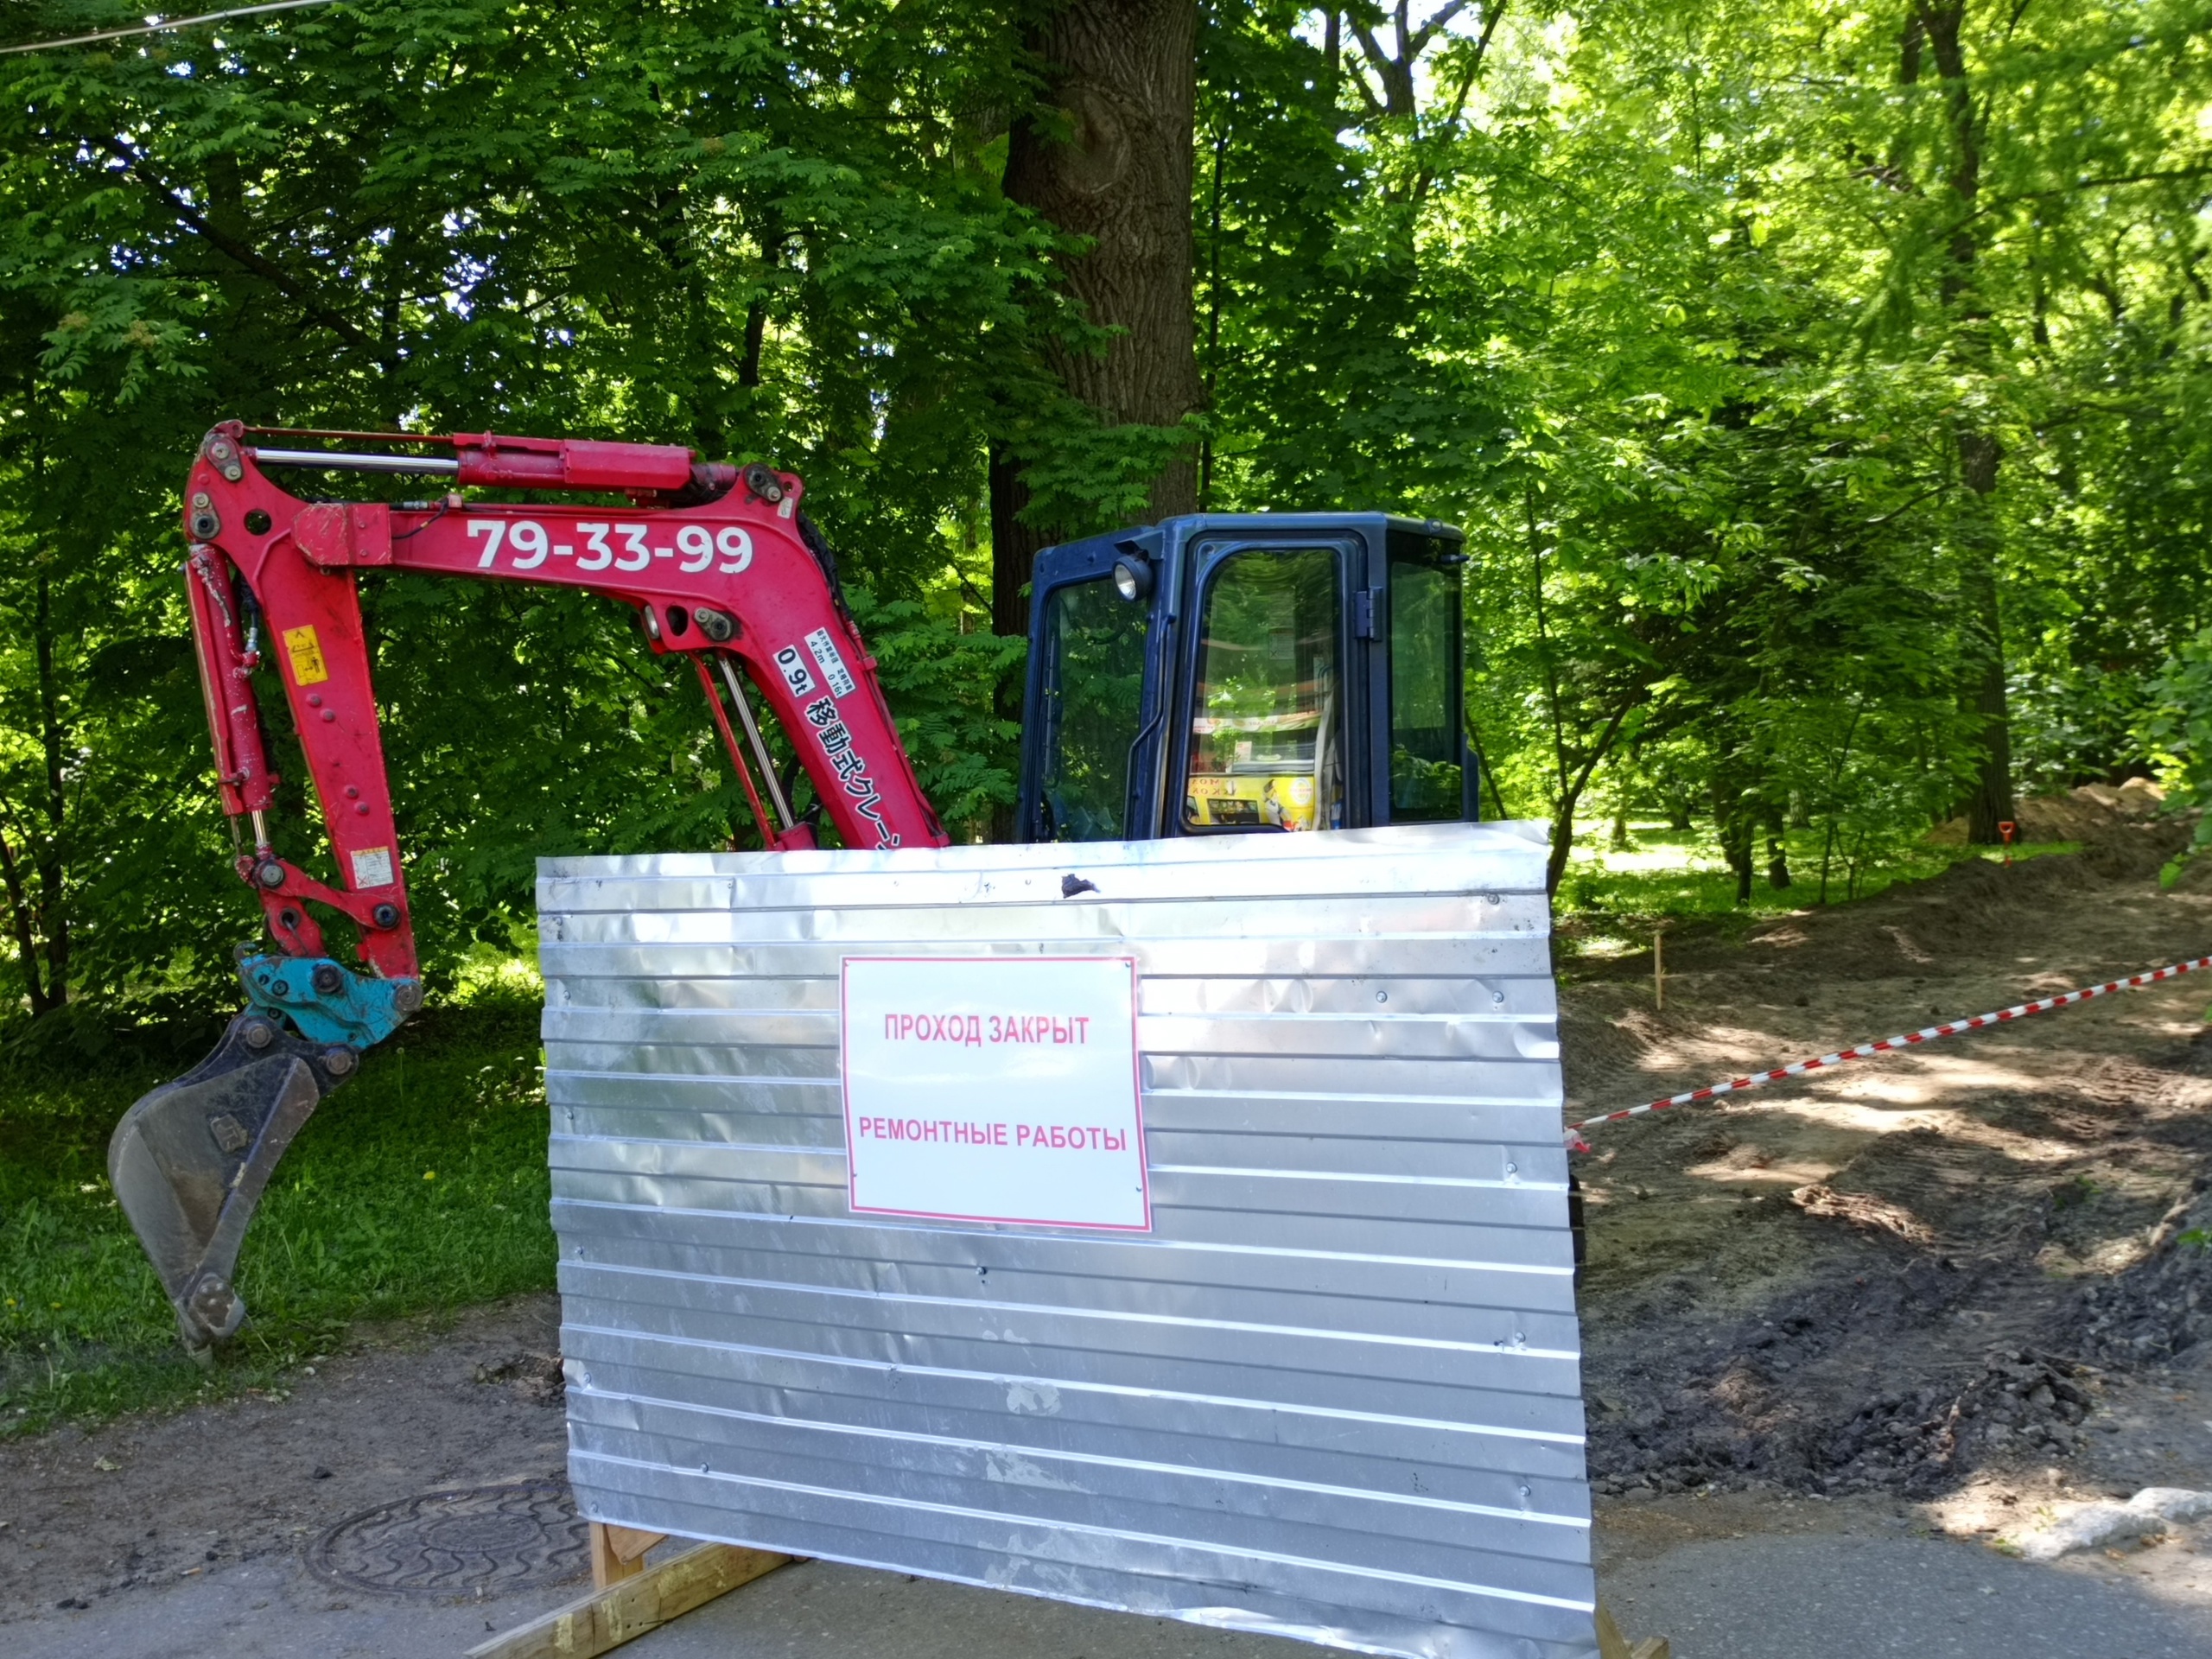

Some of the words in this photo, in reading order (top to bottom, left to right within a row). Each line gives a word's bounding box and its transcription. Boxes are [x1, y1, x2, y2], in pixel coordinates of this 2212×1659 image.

[467, 519, 753, 575] 79-33-99
[810, 640, 825, 664] 4.2m
[778, 648, 808, 695] 0.9t
[884, 1014, 982, 1048] ПРОХОД
[988, 1015, 1090, 1045] ЗАКРЫТ
[858, 1116, 1008, 1146] РЕМОНТНЫЕ
[1015, 1124, 1127, 1152] РАБОТЫ
